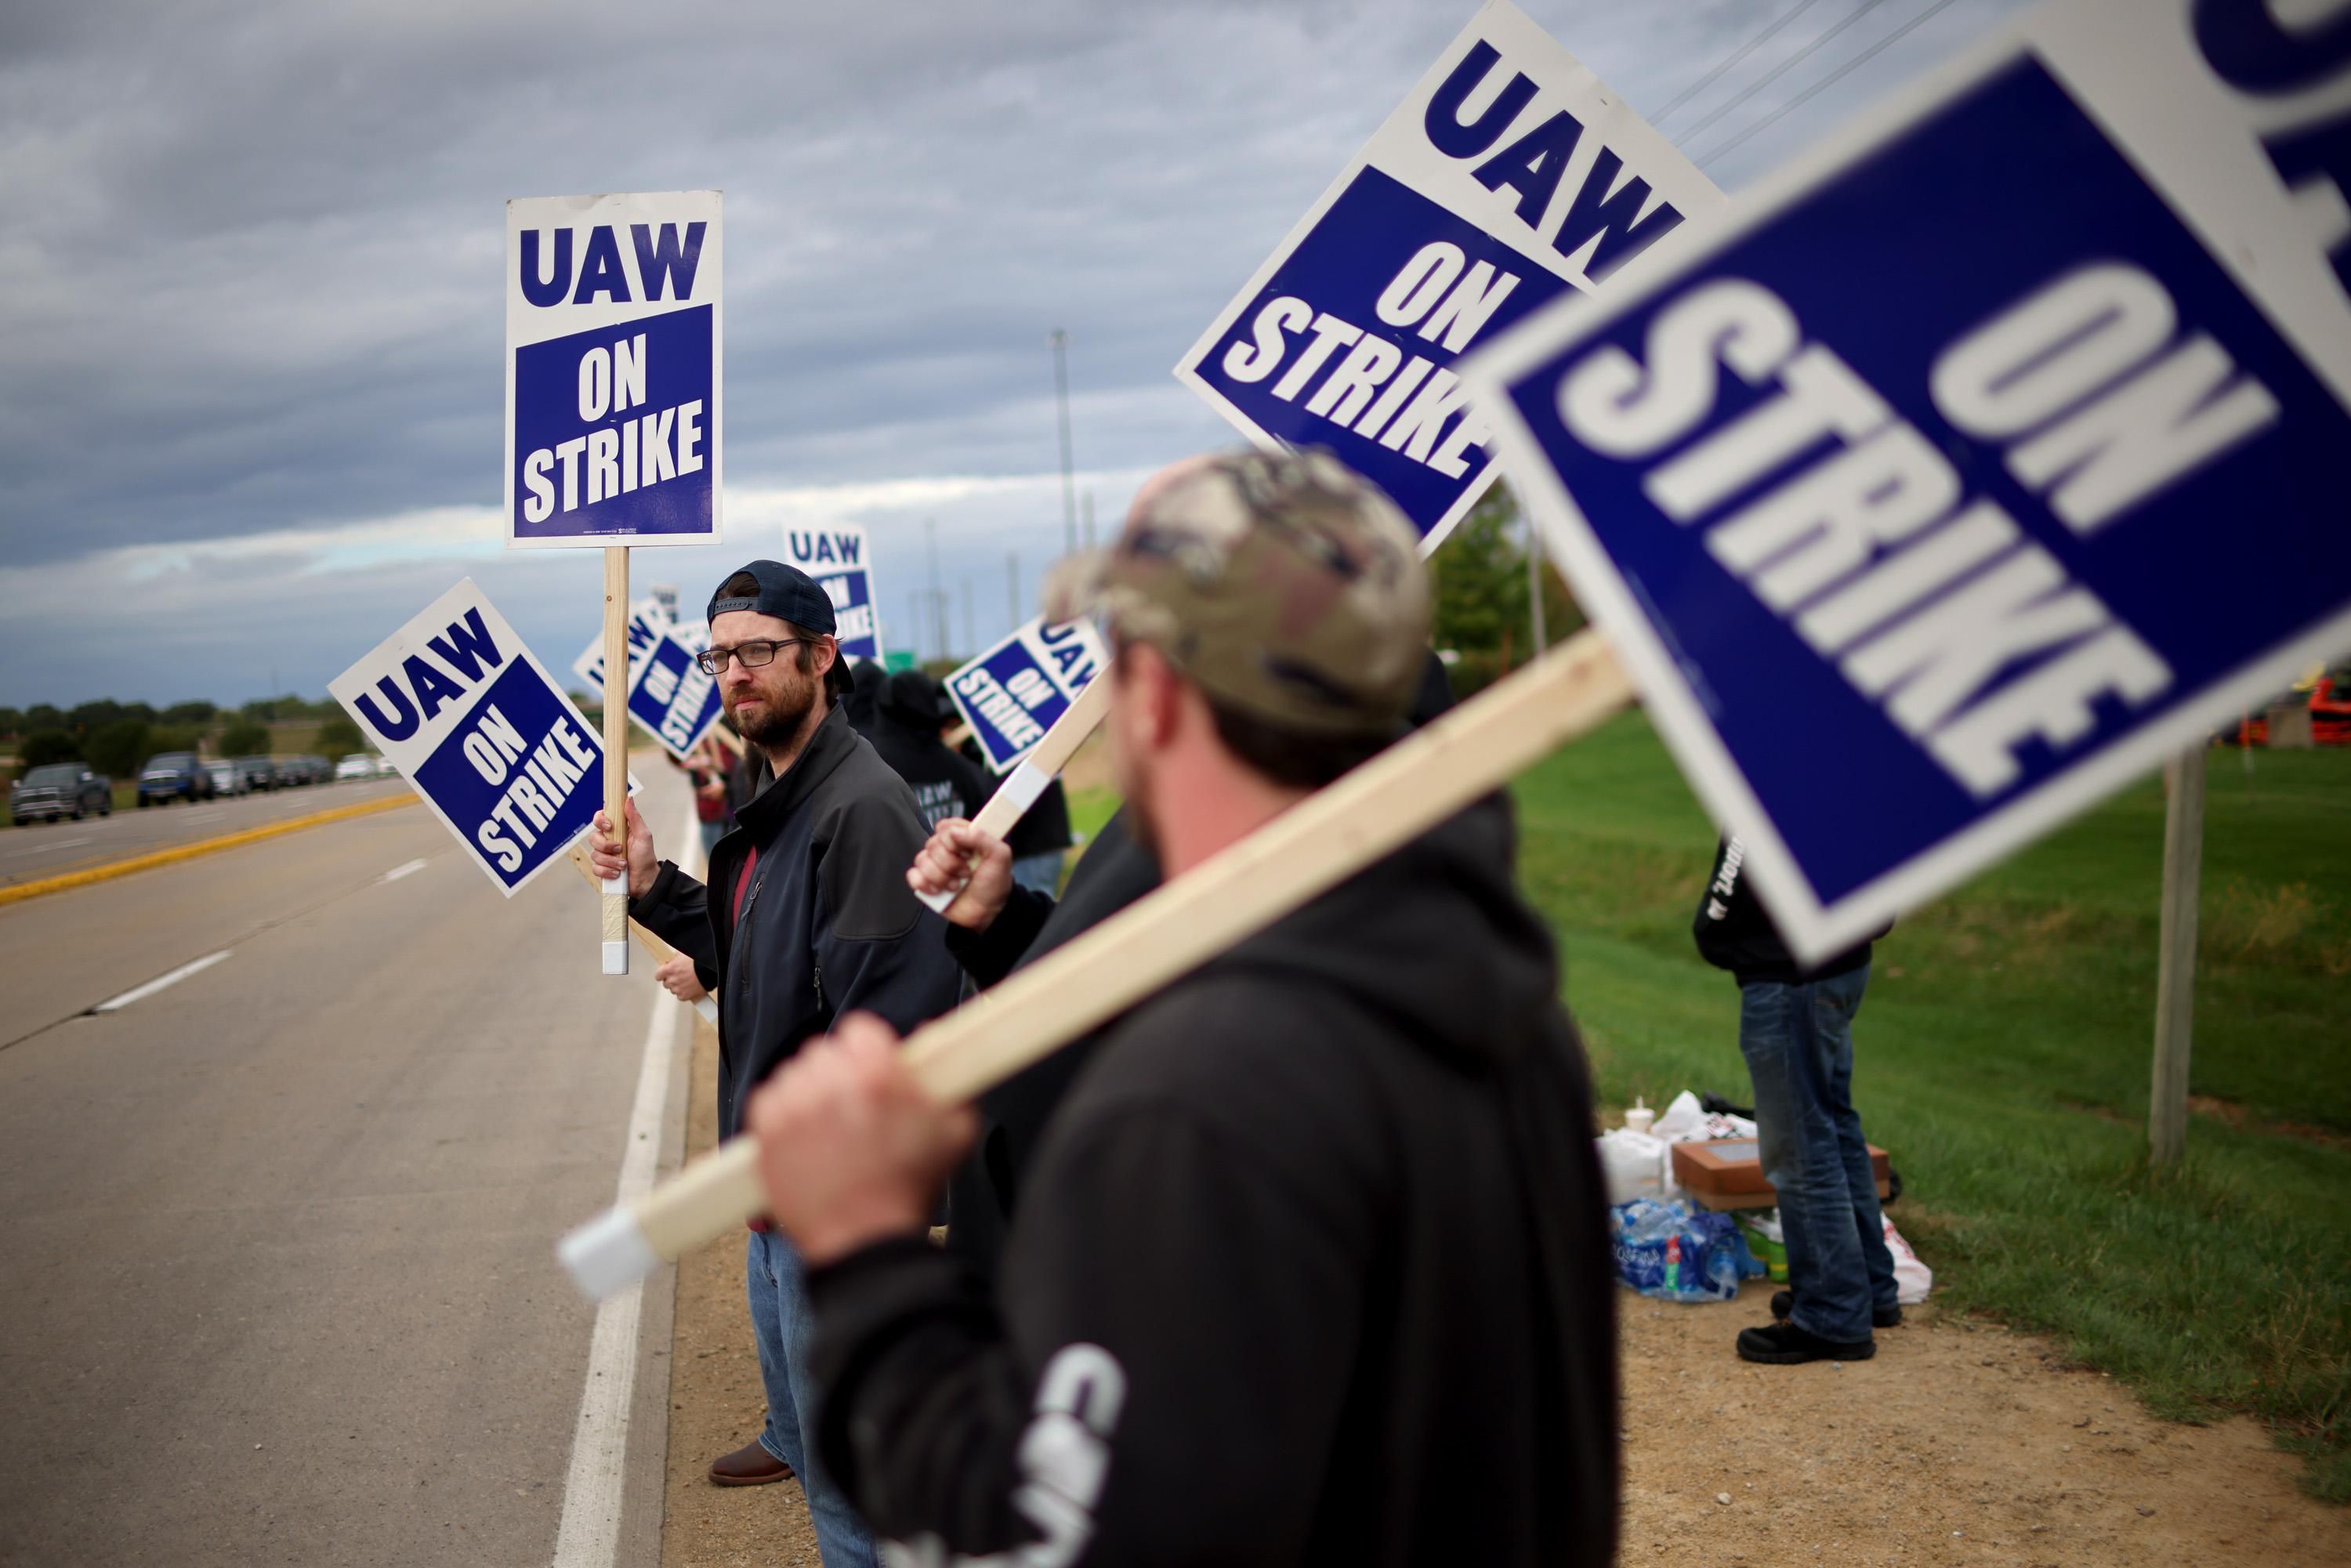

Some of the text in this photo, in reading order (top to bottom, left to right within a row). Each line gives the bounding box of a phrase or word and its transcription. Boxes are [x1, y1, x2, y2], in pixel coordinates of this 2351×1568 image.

[1424, 38, 1686, 287] UAW
[520, 221, 707, 307] UAW
[1375, 241, 1521, 354] ON
[578, 333, 647, 422] ON
[1222, 296, 1494, 480] STRIKE
[1928, 260, 2283, 539] ON
[523, 398, 703, 523] STRIKE
[790, 531, 860, 565] UAW
[1555, 277, 2177, 800] STRIKE
[353, 606, 503, 741] UAW
[956, 667, 1045, 749] STRIKE
[1005, 667, 1056, 711] ON
[463, 703, 527, 786] ON
[478, 715, 596, 872] STRIKE
